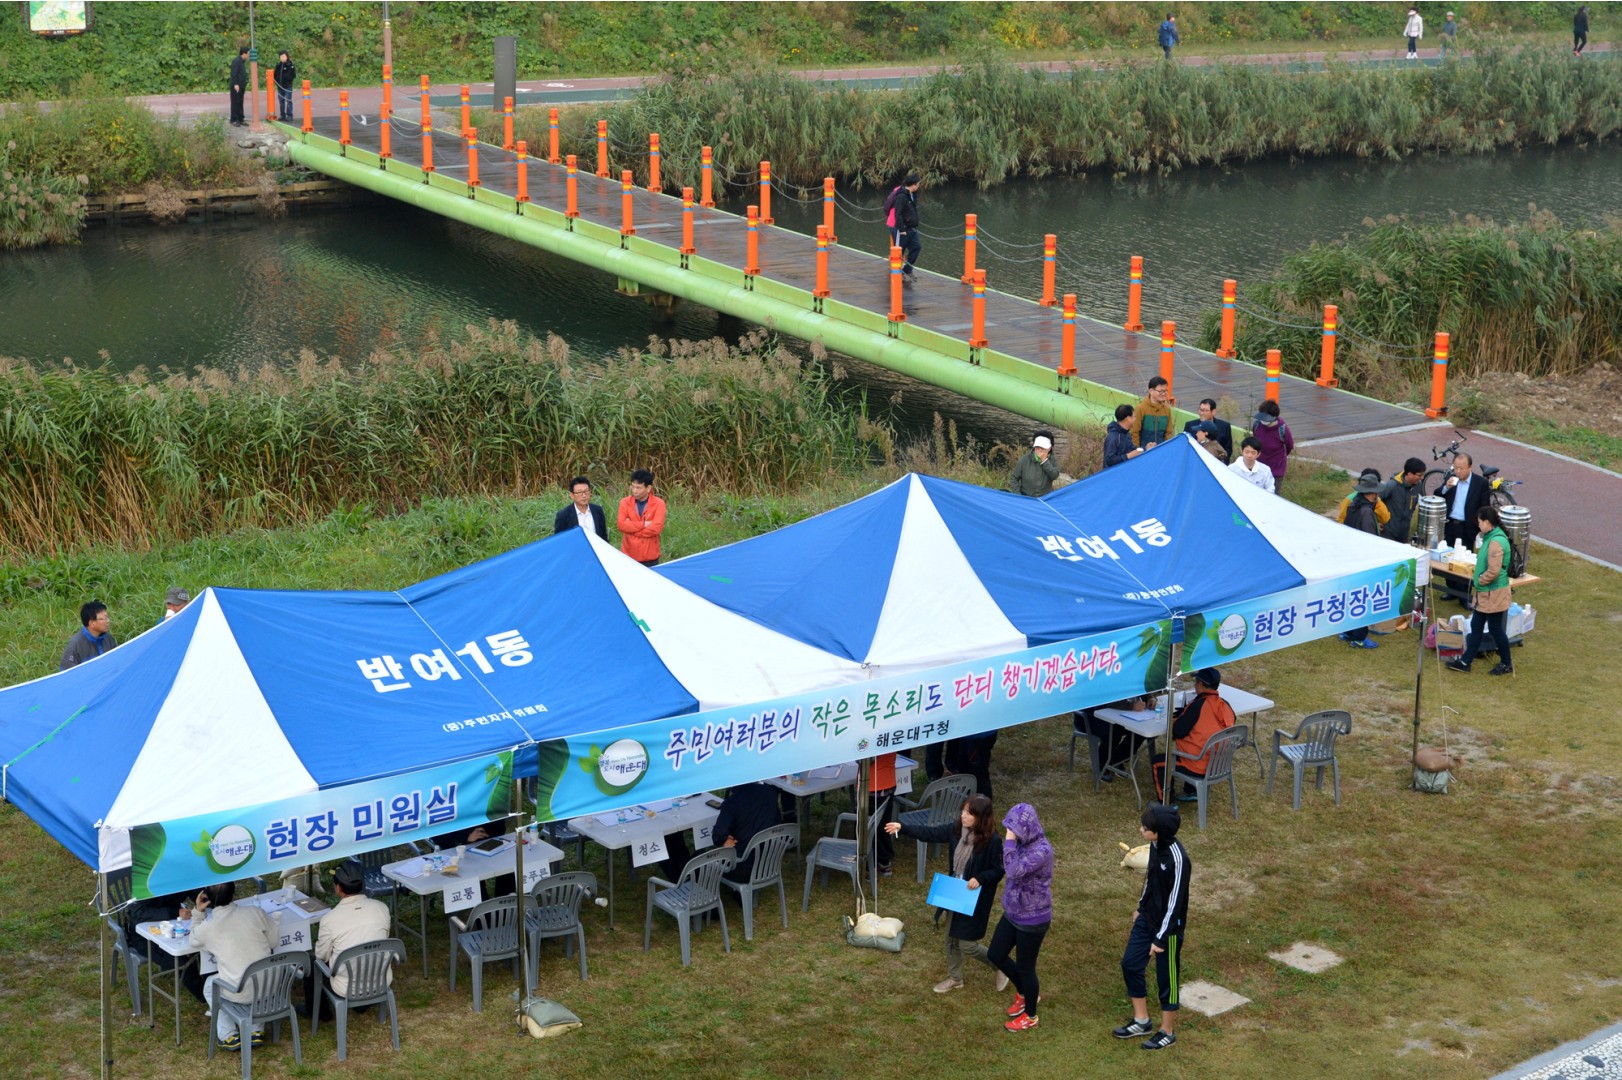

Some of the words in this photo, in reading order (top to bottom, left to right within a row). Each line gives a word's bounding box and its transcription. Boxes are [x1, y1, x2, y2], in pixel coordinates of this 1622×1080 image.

[1035, 517, 1172, 562] 반여1동
[1254, 605, 1297, 643] 현장
[1304, 580, 1391, 629] 구청장실
[356, 629, 534, 693] 반여1동
[666, 708, 800, 768] 주민여러분의
[812, 698, 851, 739] 작은
[862, 684, 943, 729] 목소리도
[955, 669, 993, 708] 단디
[1002, 645, 1121, 698] 챙기겠습니다.
[876, 719, 950, 748] 해운대구청
[266, 810, 339, 860] 현장
[353, 784, 457, 842] 민원실
[638, 841, 661, 857] 청소
[451, 886, 475, 903] 교통
[280, 931, 305, 947] 교육
